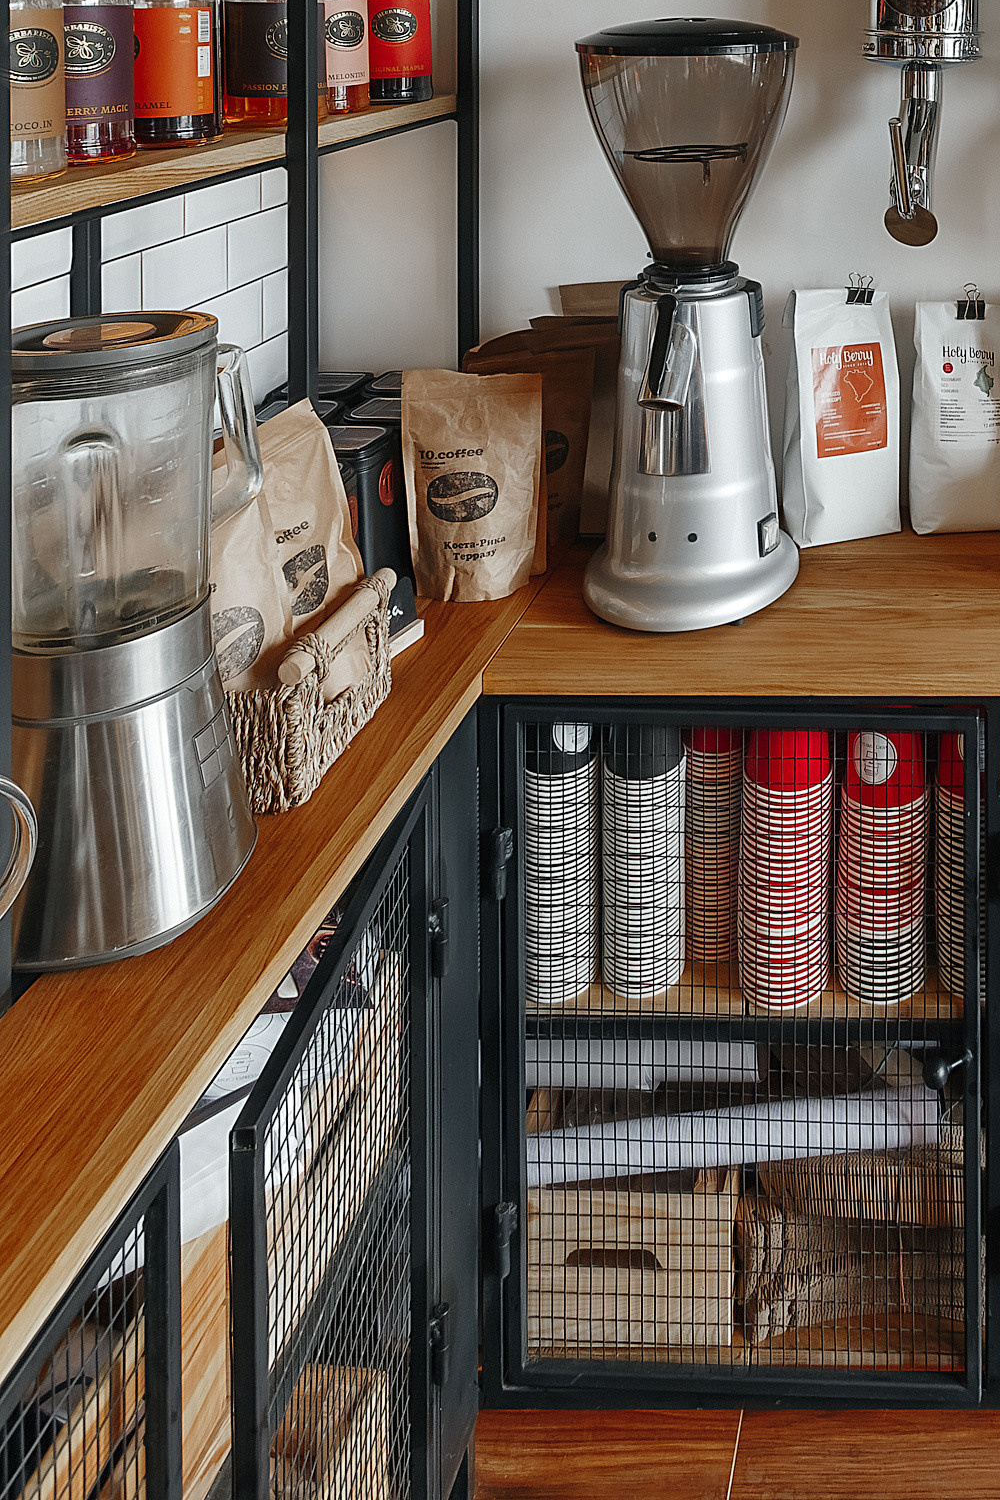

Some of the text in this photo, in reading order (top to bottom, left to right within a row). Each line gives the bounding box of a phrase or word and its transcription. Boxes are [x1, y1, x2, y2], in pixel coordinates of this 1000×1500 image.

[242, 83, 279, 91] PASSION
[100, 103, 129, 114] MAGIC
[820, 349, 874, 371] Holy Berry
[942, 345, 995, 367] Holy Berry
[443, 536, 506, 550] Коста-Рика
[453, 549, 497, 561] Терразу
